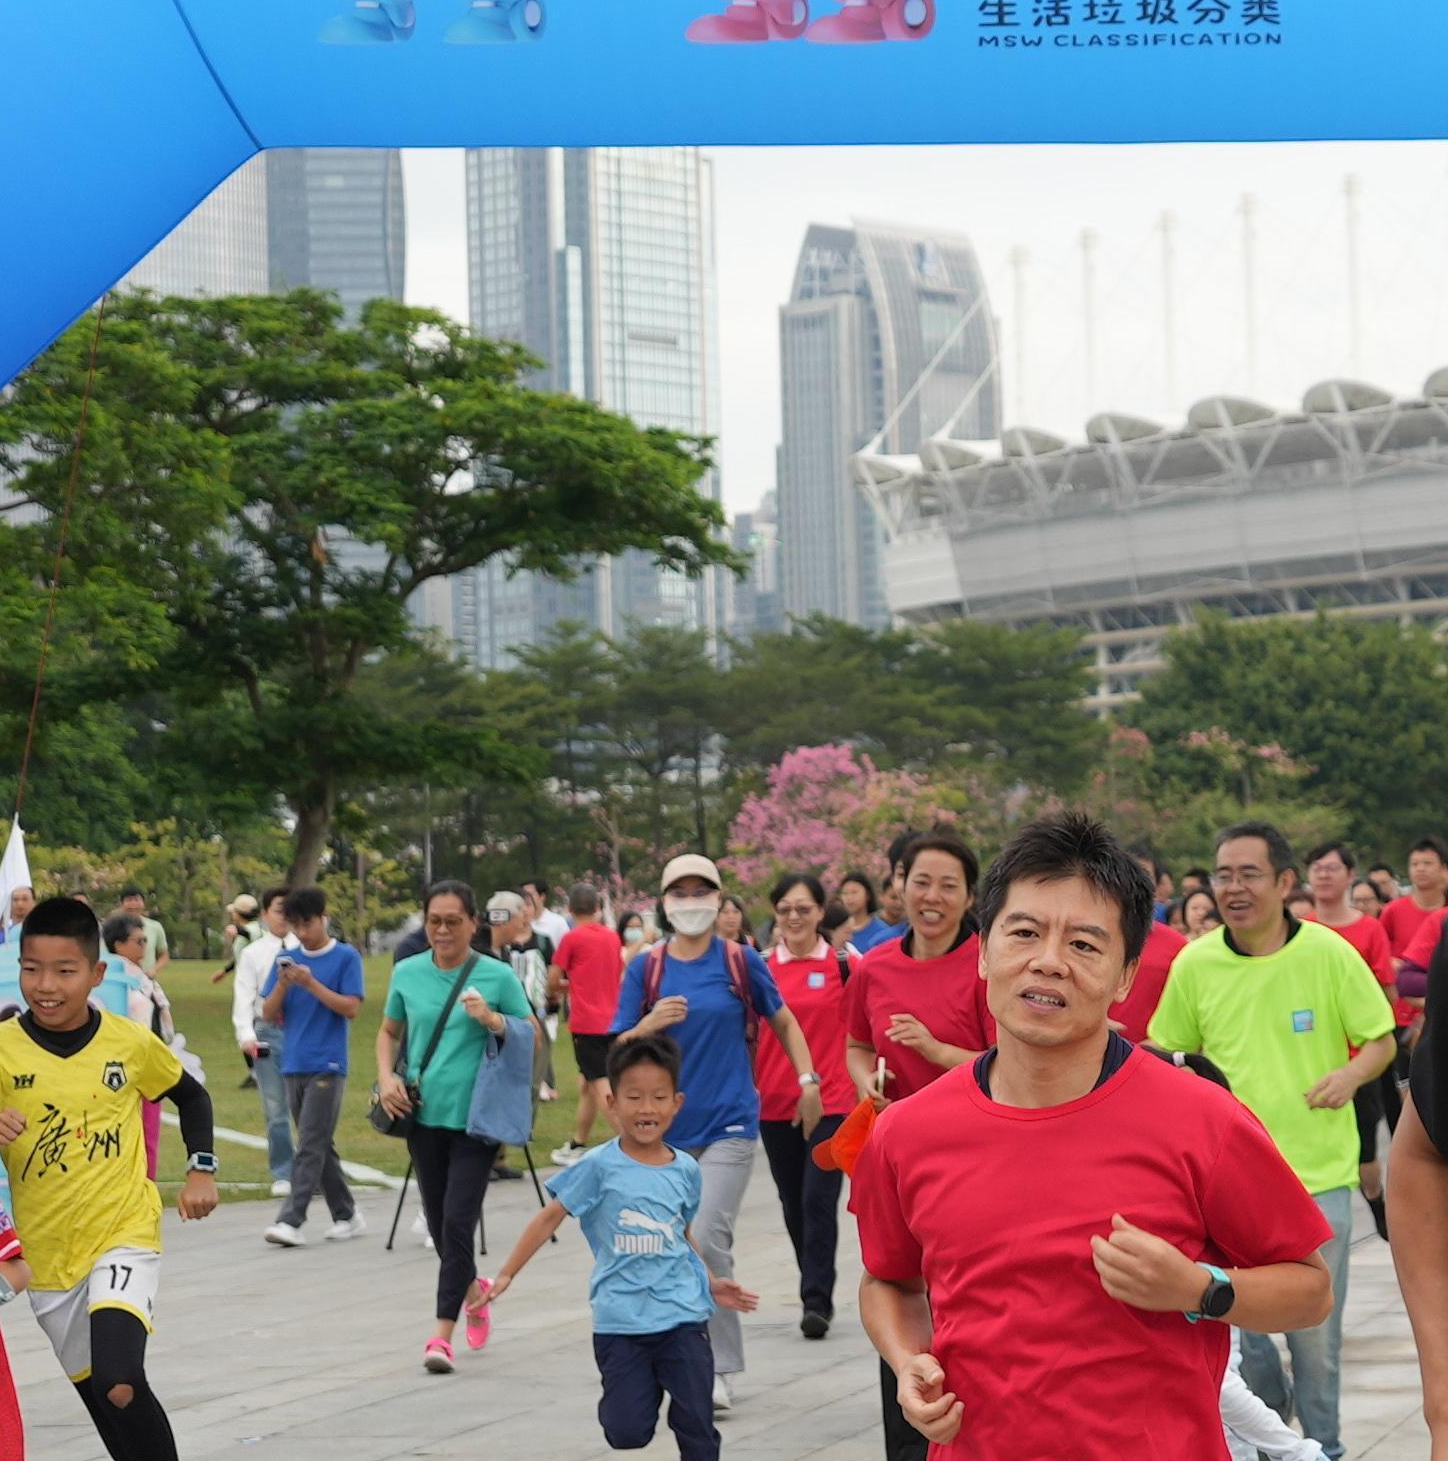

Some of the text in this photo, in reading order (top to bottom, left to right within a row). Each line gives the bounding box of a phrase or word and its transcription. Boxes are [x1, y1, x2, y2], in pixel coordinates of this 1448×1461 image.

[978, 32, 1282, 48] MSW CLASSIFICATION
[109, 1264, 133, 1291] 17
